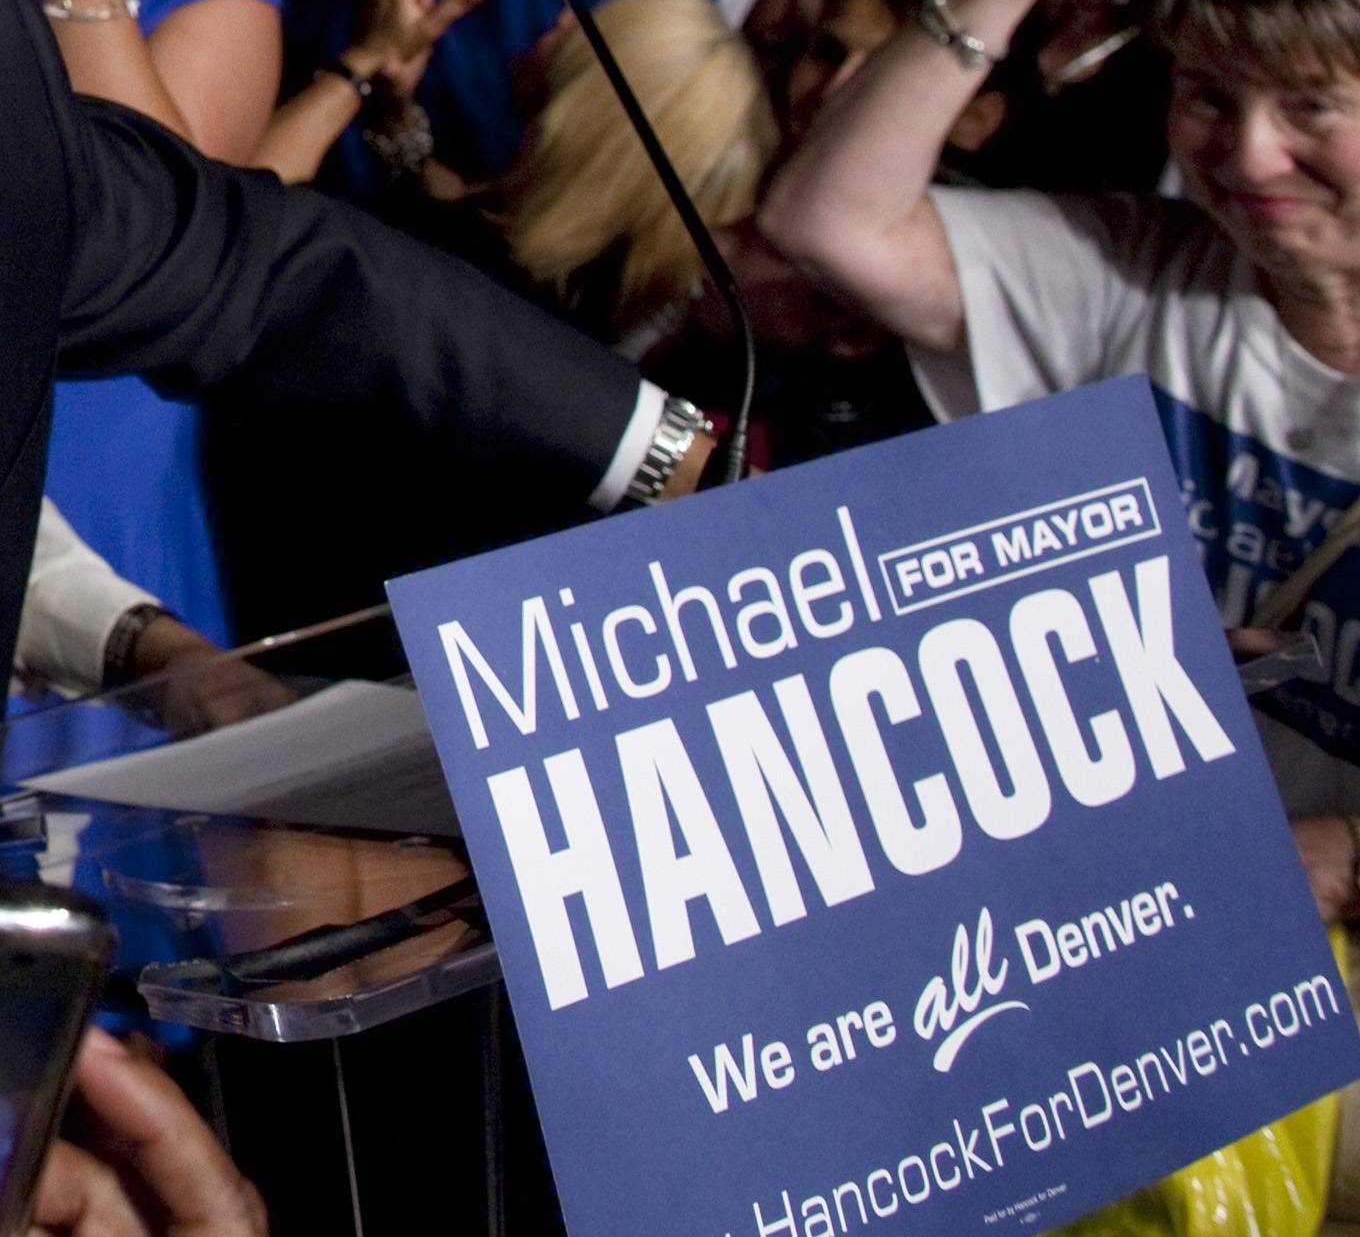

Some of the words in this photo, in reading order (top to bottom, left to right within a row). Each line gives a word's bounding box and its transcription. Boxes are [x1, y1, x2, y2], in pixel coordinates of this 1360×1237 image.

[437, 505, 882, 750] Michael
[895, 542, 984, 597] FOR
[993, 493, 1143, 568] MAYOR
[486, 554, 1238, 1011] HANCOCK
[687, 1033, 796, 1114] We
[806, 999, 897, 1072] are
[913, 906, 1020, 1058] all
[1014, 881, 1195, 986] Denver.
